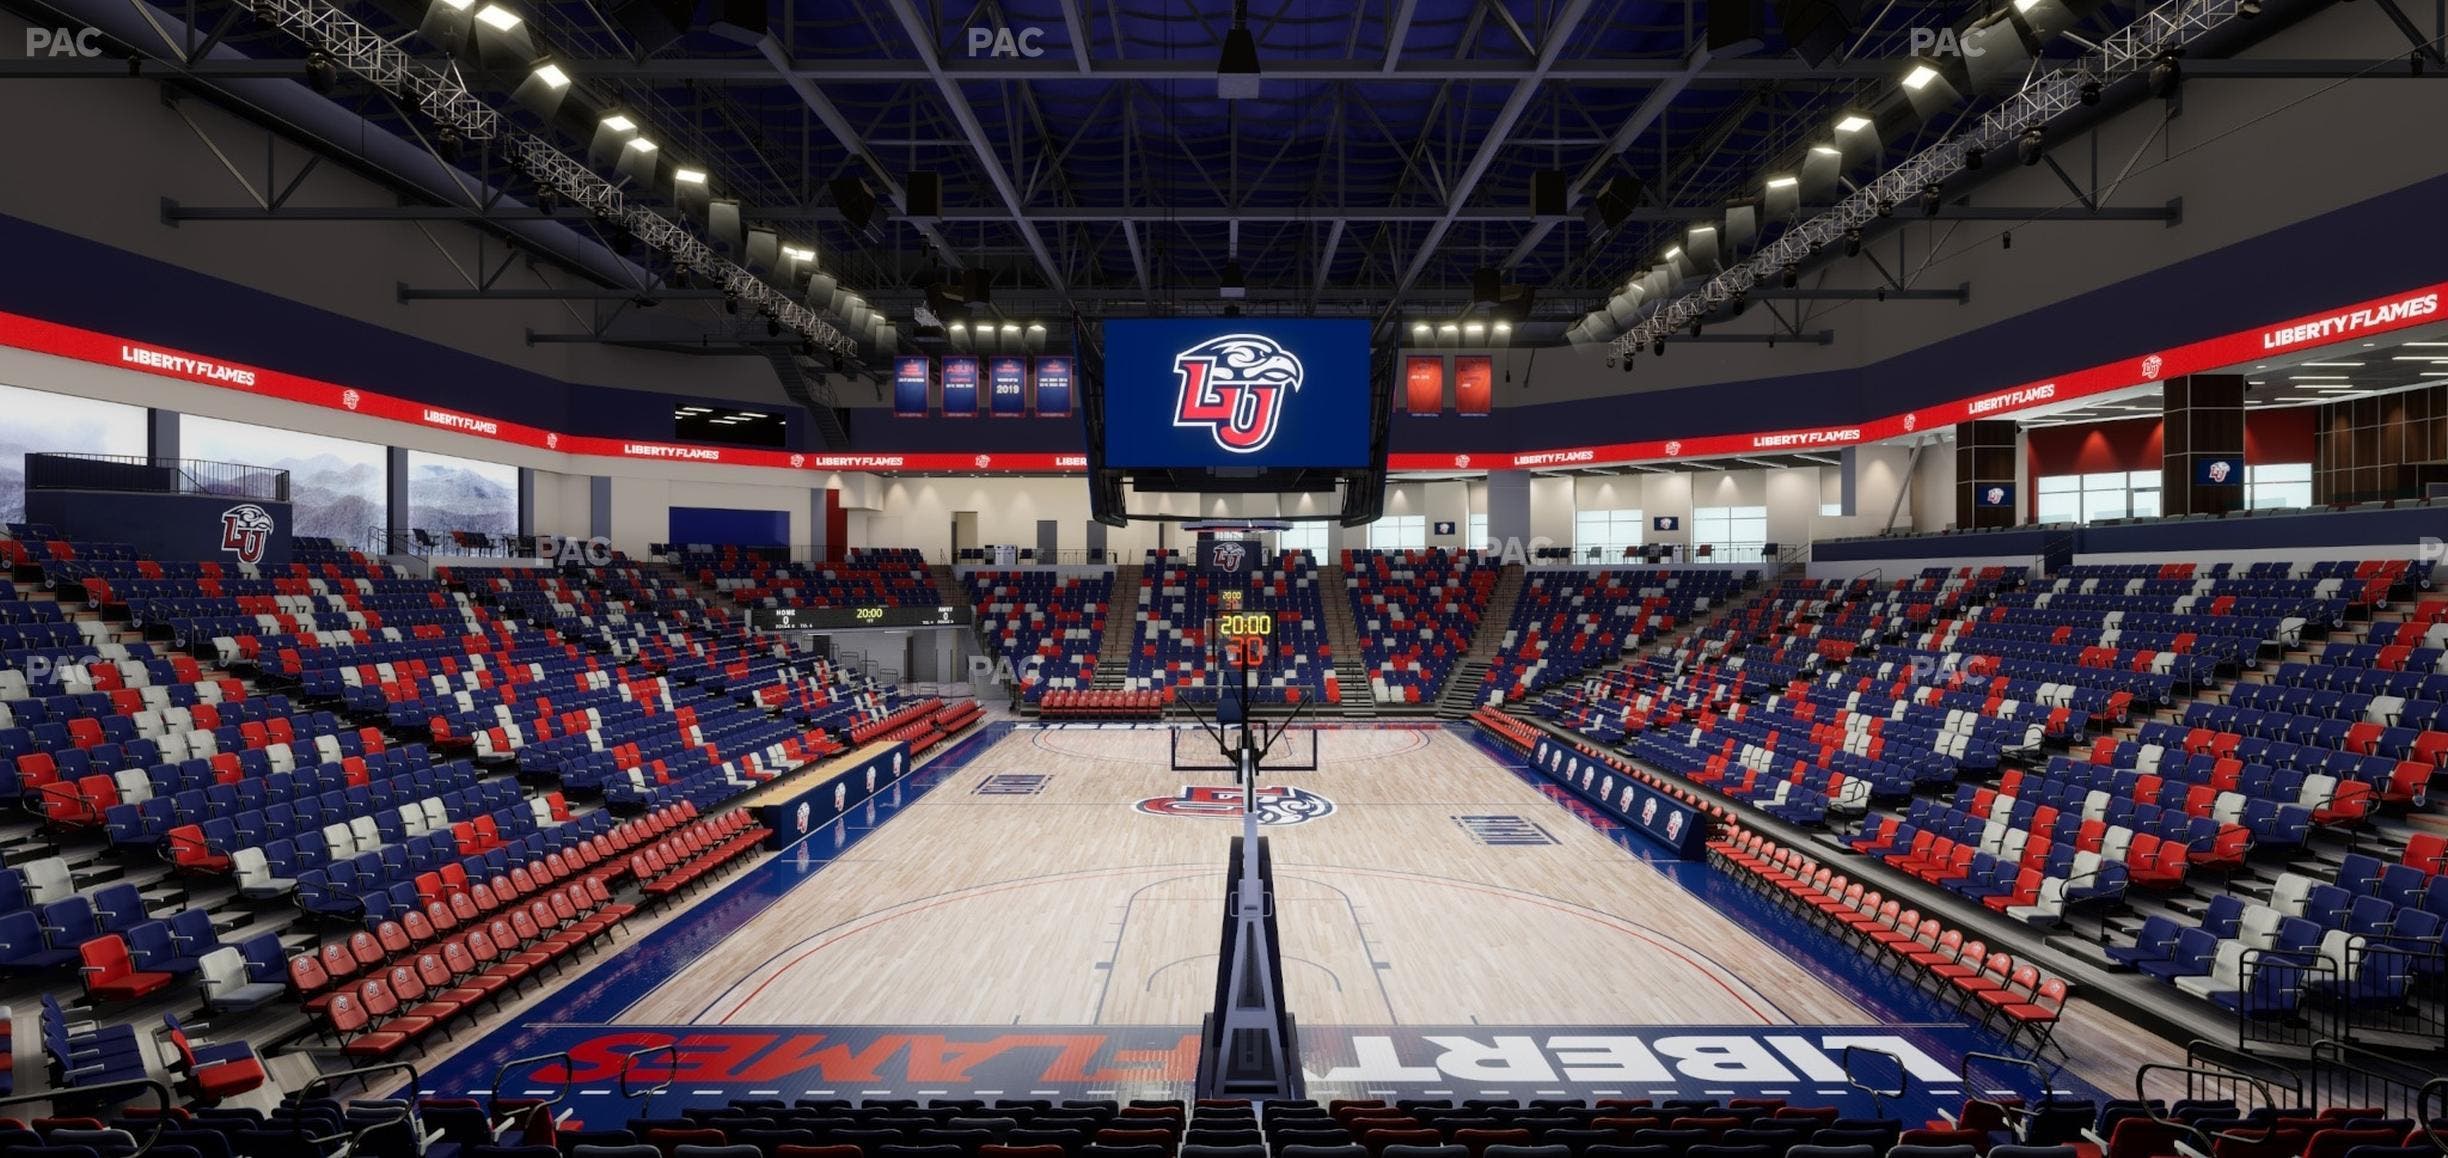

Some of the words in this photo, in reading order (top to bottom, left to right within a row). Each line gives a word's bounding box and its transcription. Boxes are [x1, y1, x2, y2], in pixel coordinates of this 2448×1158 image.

[2264, 316, 2349, 348] LIBERTY
[2349, 294, 2438, 330] FLAMES
[122, 346, 195, 374] LIBERTY
[197, 361, 255, 386] FLAMES
[997, 385, 1019, 394] 2019
[1969, 395, 2013, 414] LIBERTY
[2012, 384, 2055, 405] FLAMES
[424, 409, 465, 429] LIBERTY
[464, 418, 497, 434] FLAMES
[1754, 434, 1808, 447] LIBERTY
[1808, 430, 1861, 443] FLAMES
[625, 444, 676, 457] LIBERTY
[676, 448, 720, 460] FLAMES
[1514, 453, 1555, 466] LIBERTY
[1554, 450, 1594, 462] FLAMES
[816, 457, 862, 466] LIBERTY
[862, 457, 904, 466] FLAMES
[783, 616, 790, 625] 0
[857, 608, 883, 618] 20:00
[943, 612, 949, 621] 0
[1221, 615, 1271, 635] 20:00
[528, 1033, 1200, 1083] FLAMES
